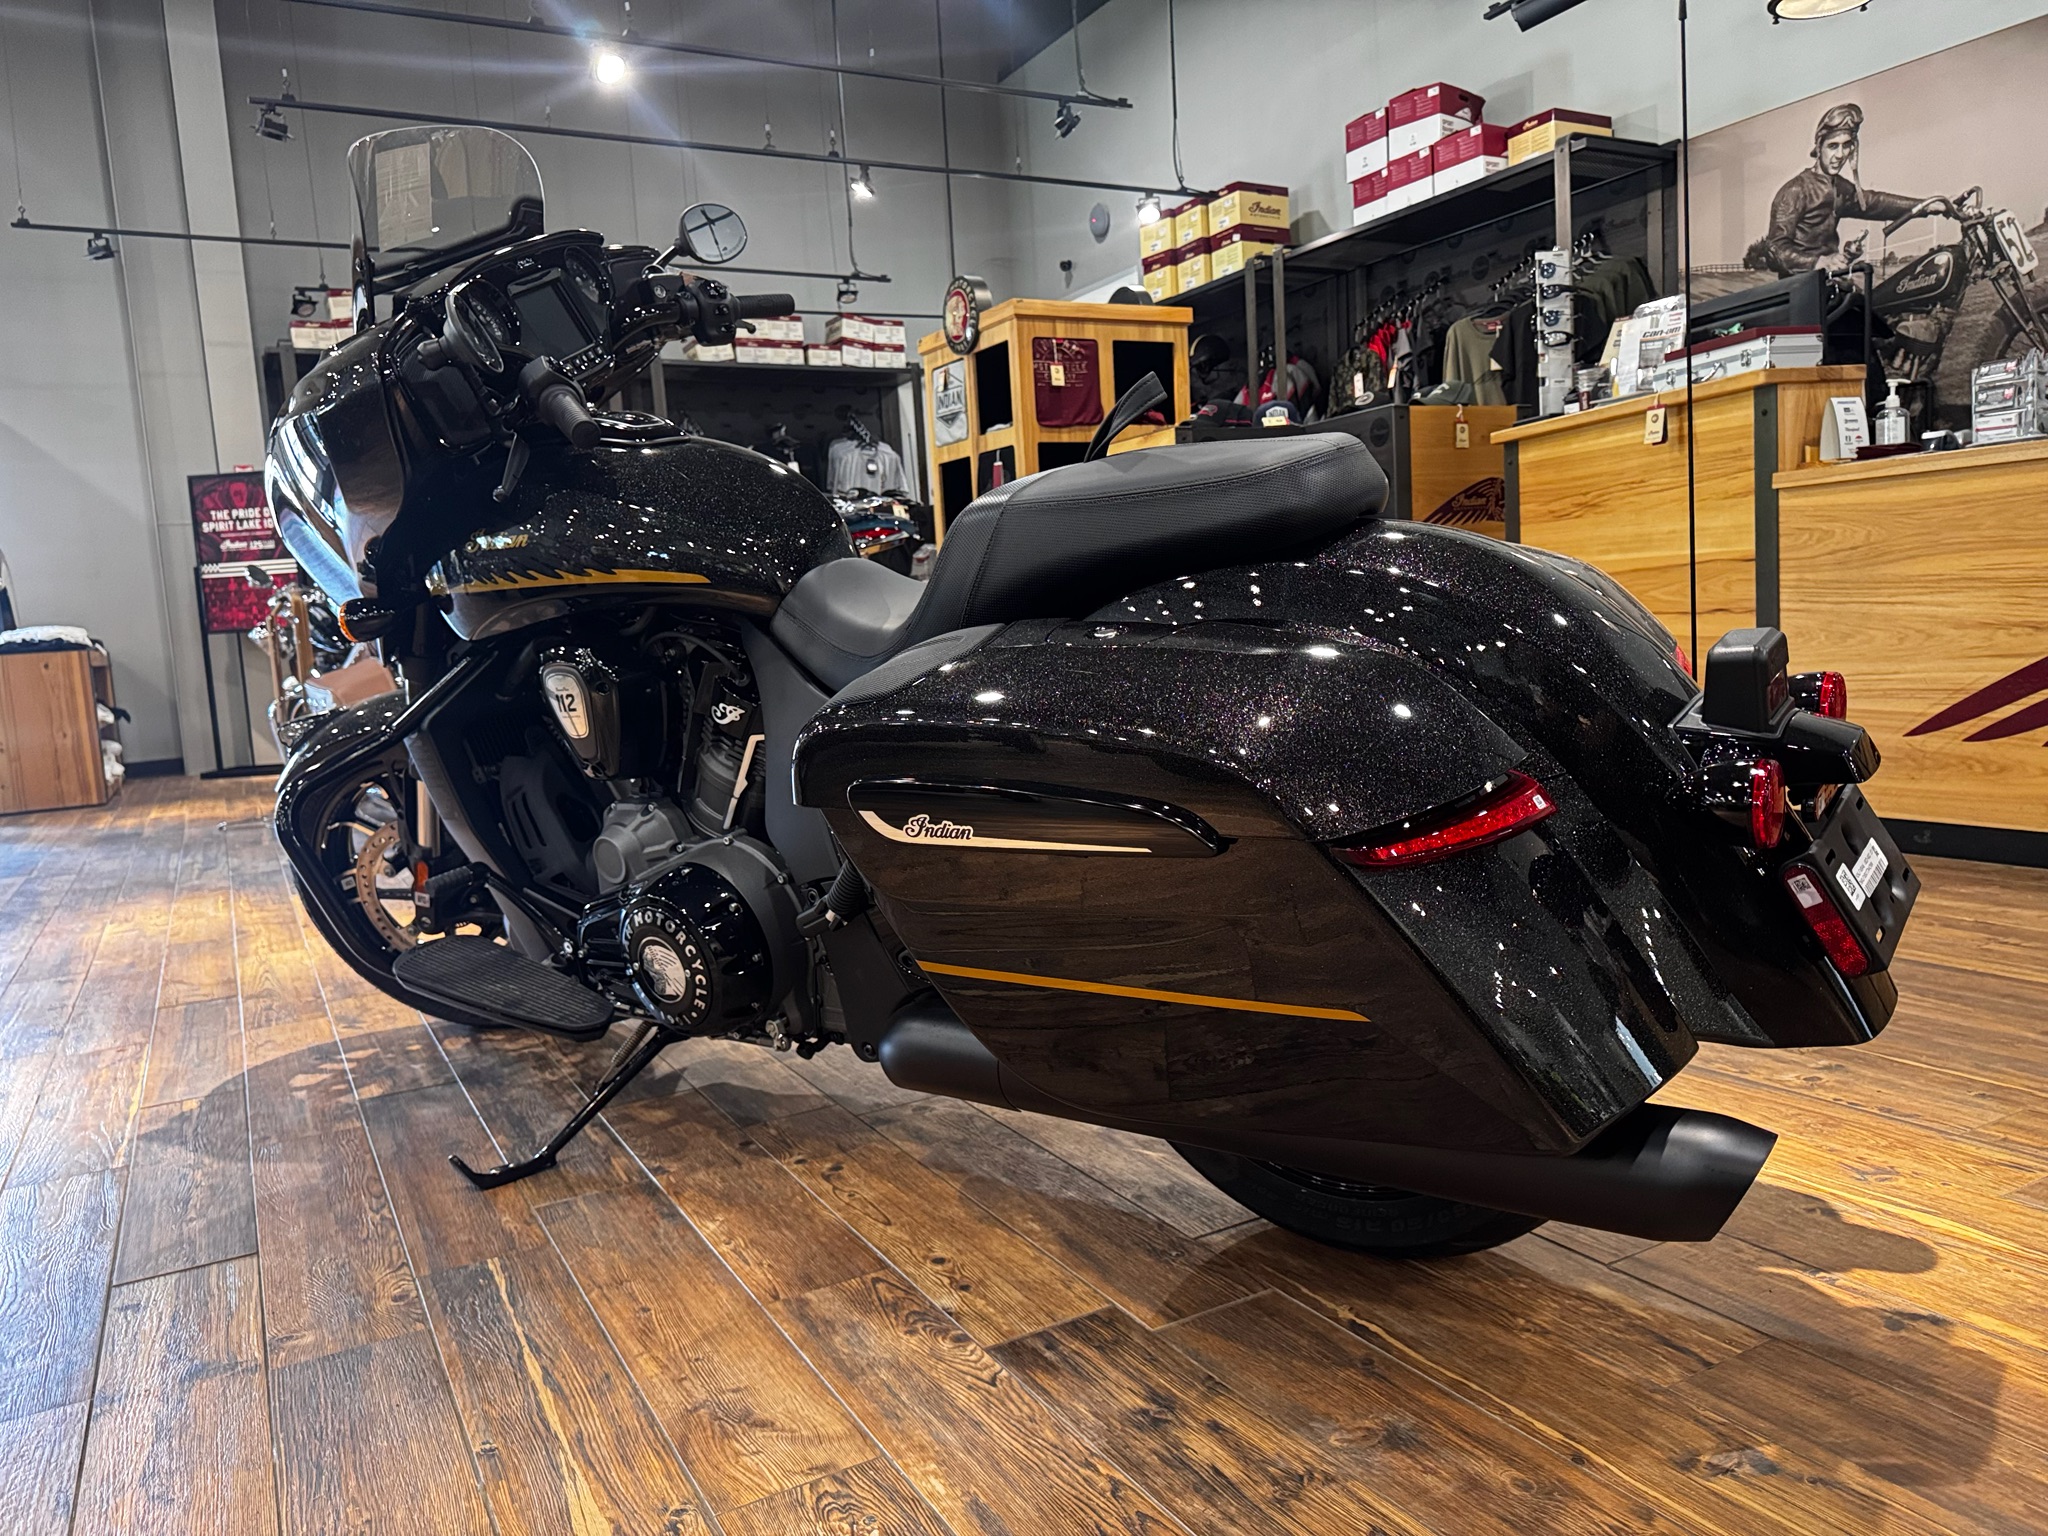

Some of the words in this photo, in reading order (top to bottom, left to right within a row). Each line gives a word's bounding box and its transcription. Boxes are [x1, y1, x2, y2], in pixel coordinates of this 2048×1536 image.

[1248, 201, 1281, 215] Indian
[1996, 217, 2035, 268] 52
[1896, 273, 1938, 294] Indian
[210, 508, 230, 521] THE
[231, 507, 261, 519] PRIDE
[202, 520, 234, 533] SPIRIT
[236, 519, 262, 531] LAKE
[263, 518, 274, 529] IO
[555, 693, 577, 713] 112
[905, 815, 971, 840] Indian
[633, 911, 707, 1010] MOTORCYCLE
